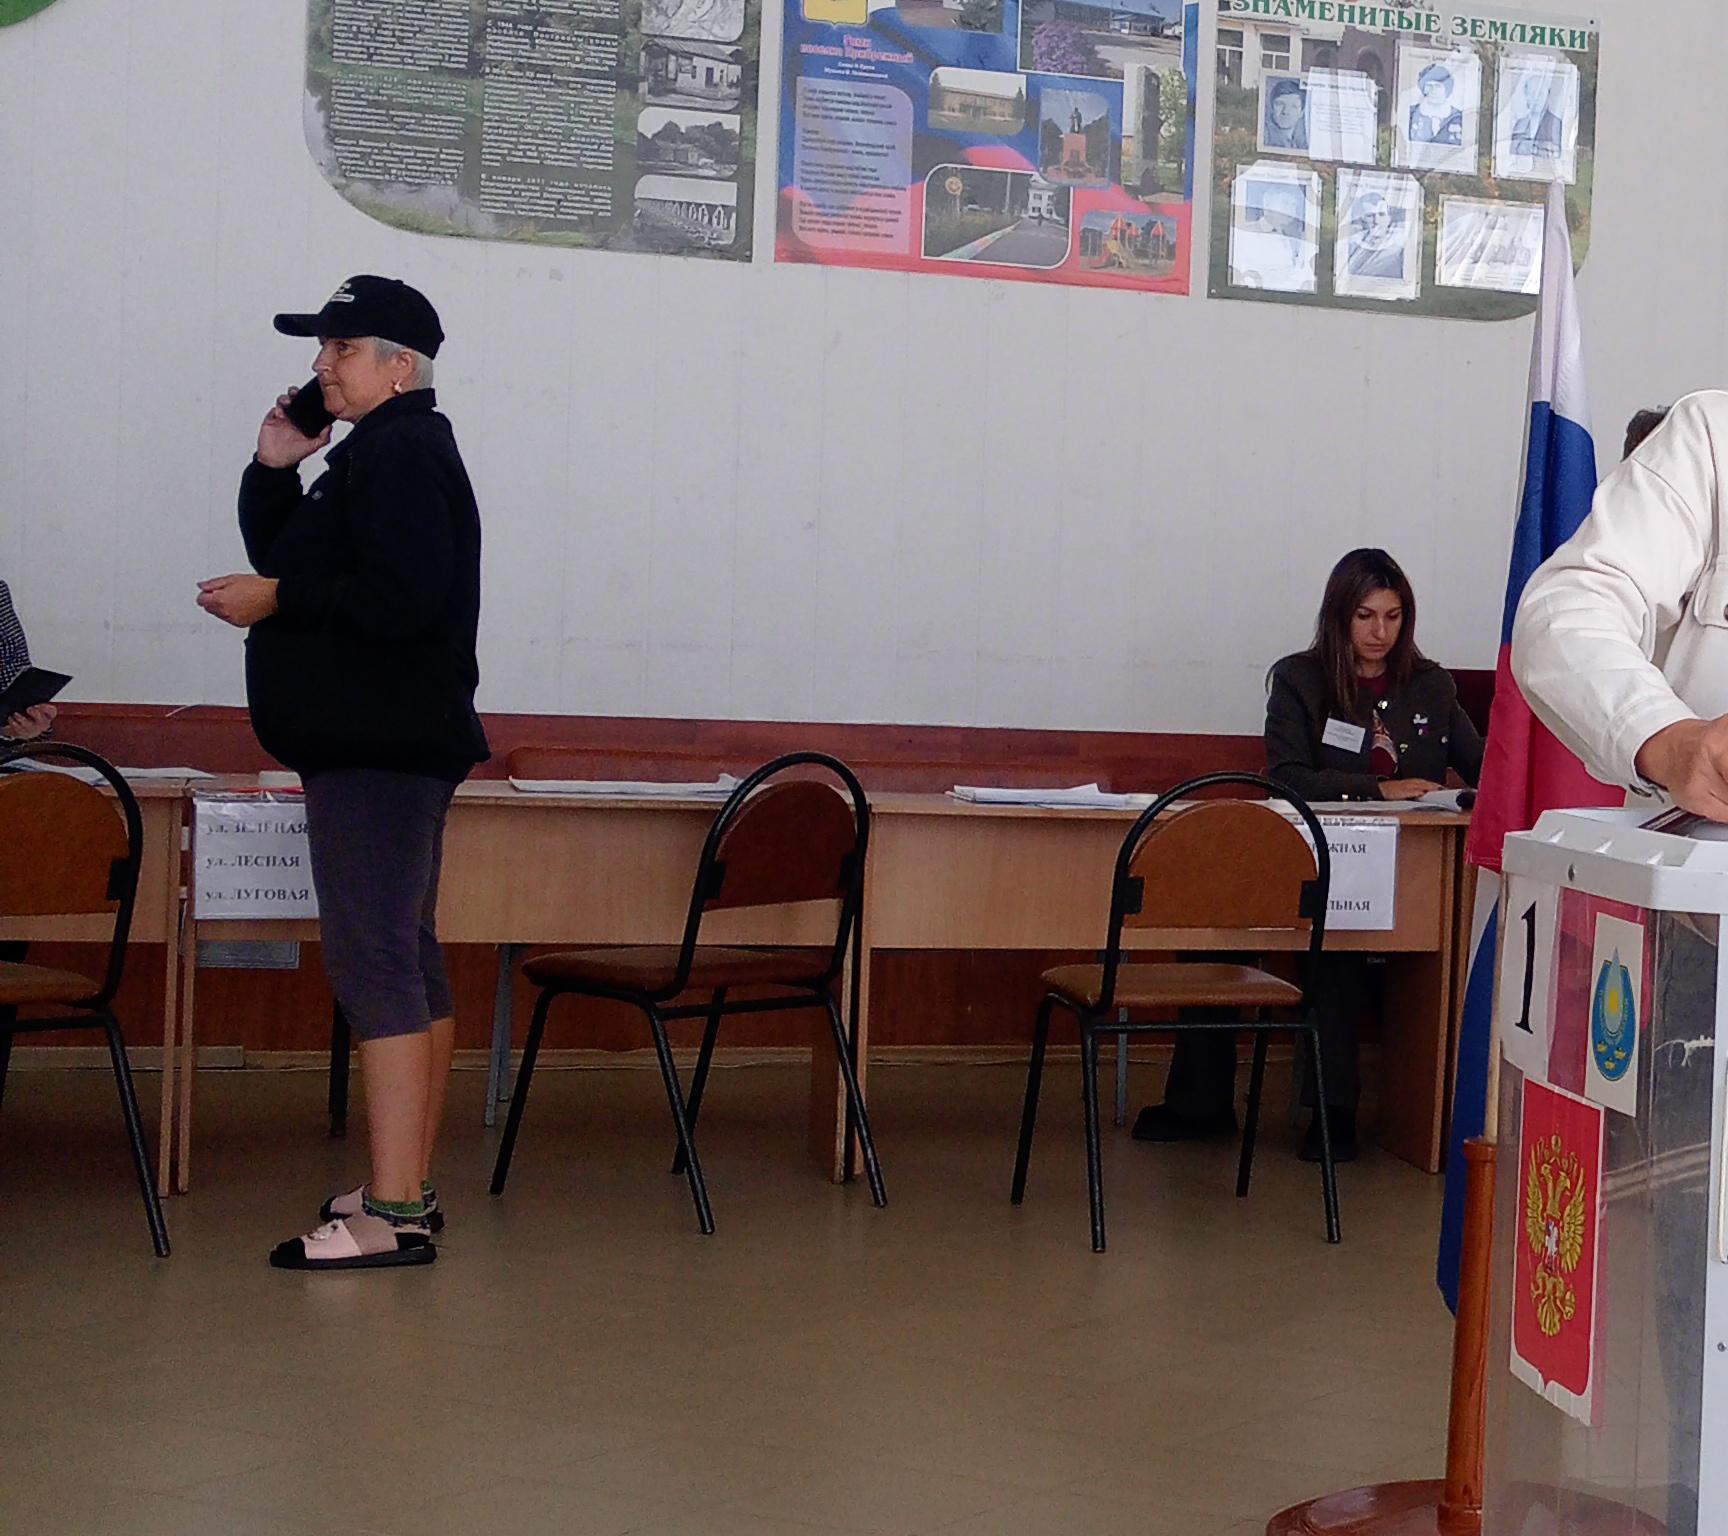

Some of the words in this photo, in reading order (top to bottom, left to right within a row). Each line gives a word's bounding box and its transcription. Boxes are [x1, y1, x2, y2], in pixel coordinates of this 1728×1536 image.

[1451, 15, 1588, 50] ЗЕМЛЯКИ
[231, 855, 300, 867] ЛЕСНАЯ
[230, 888, 309, 901] ЛУГОВАЯ
[1515, 900, 1537, 1035] 1
